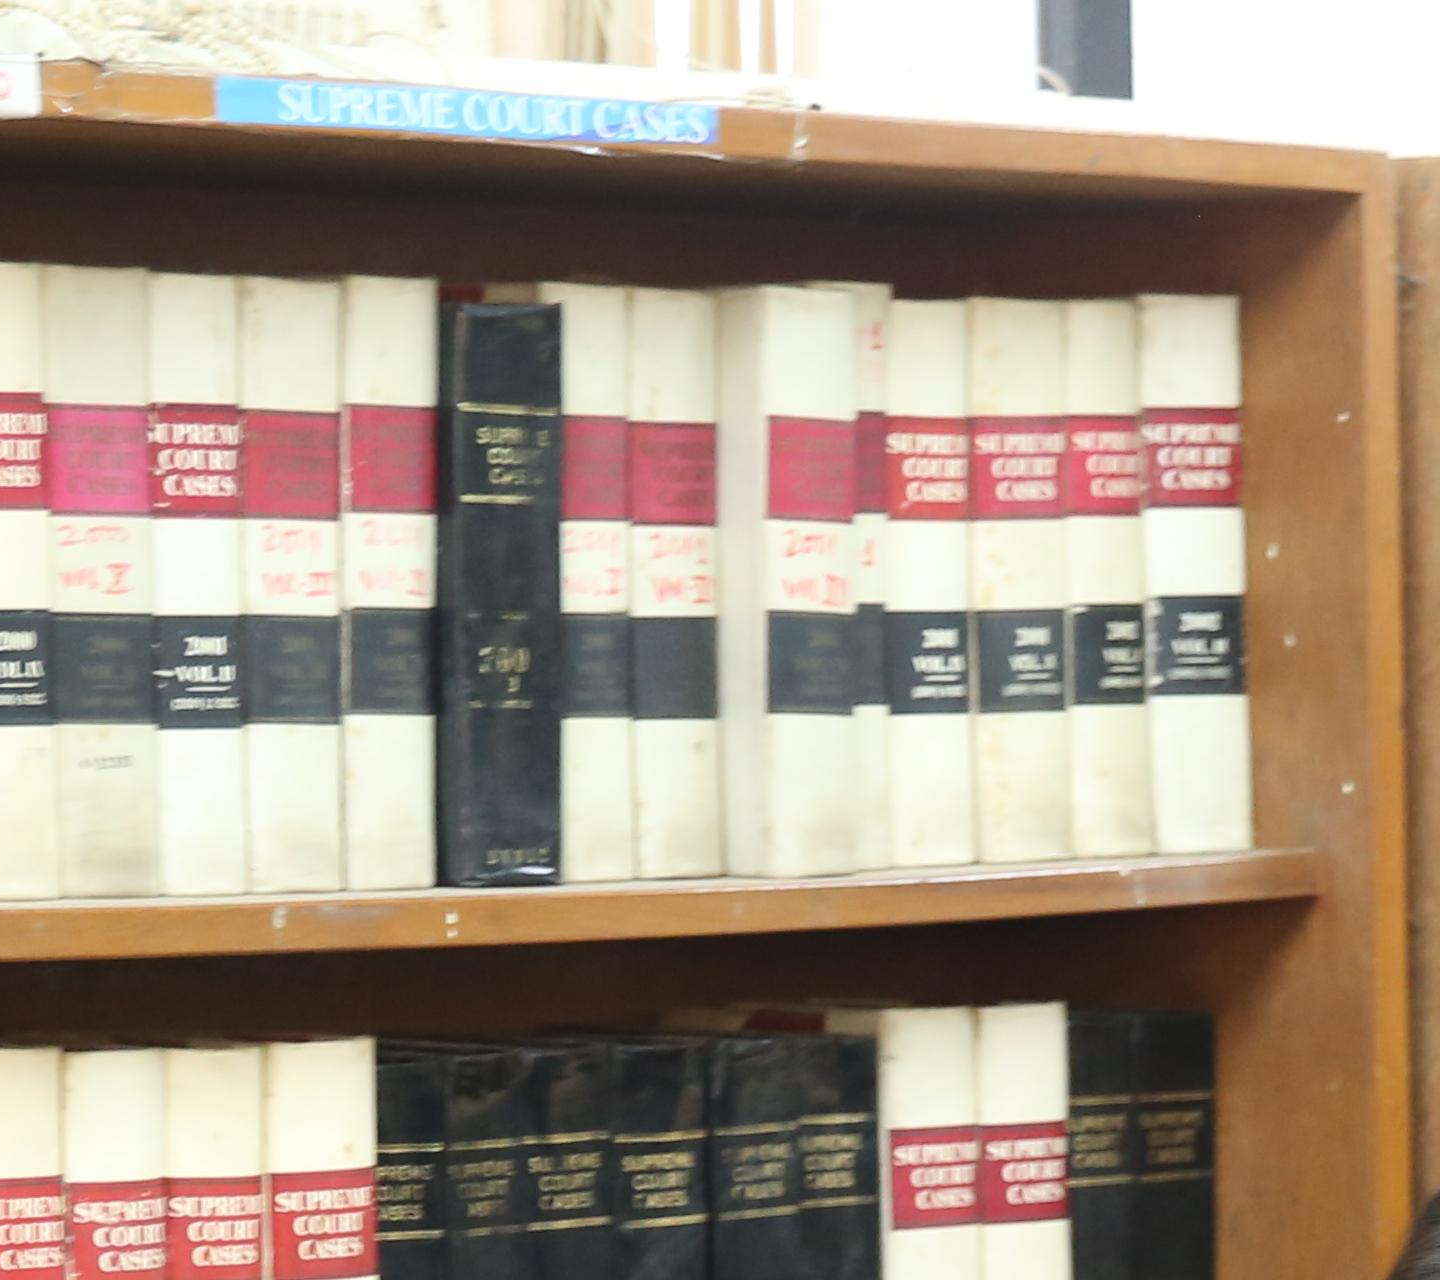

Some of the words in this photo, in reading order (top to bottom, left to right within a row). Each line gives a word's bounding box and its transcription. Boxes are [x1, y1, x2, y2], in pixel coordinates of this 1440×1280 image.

[278, 81, 454, 130] SUPREME
[462, 92, 590, 137] COURT
[594, 100, 709, 143] CASES
[157, 448, 237, 472] COURT
[1156, 447, 1232, 467] COURT
[163, 474, 237, 496] CASES
[1162, 469, 1232, 491] CASES
[187, 1219, 259, 1242] COURT
[292, 1212, 364, 1236] COURT
[97, 1249, 166, 1273] CASES
[191, 1243, 258, 1268] CASES
[298, 1237, 363, 1261] CASES
